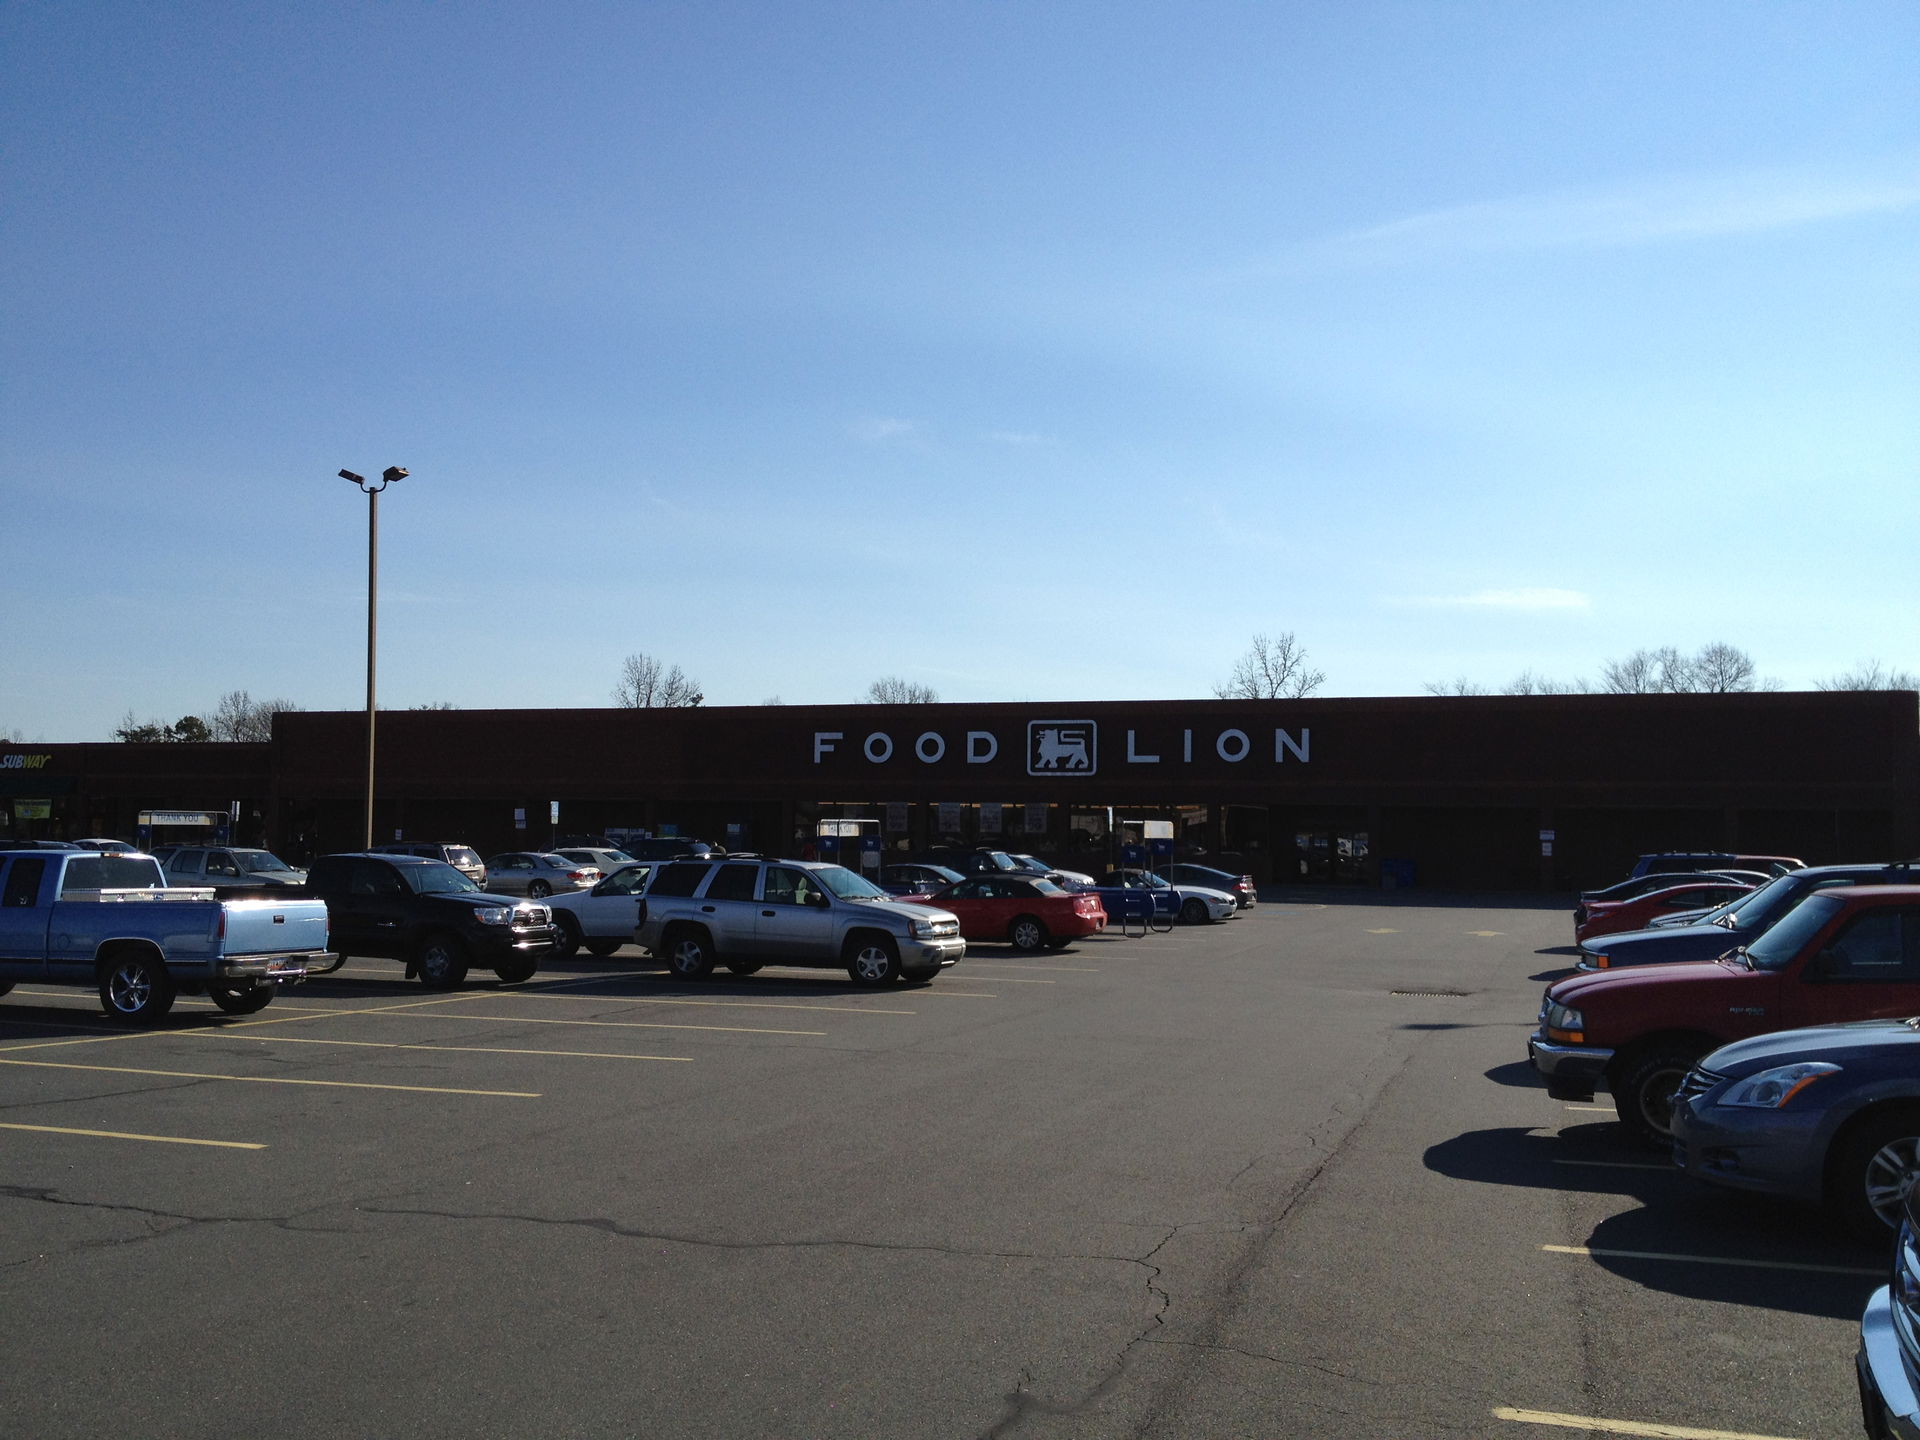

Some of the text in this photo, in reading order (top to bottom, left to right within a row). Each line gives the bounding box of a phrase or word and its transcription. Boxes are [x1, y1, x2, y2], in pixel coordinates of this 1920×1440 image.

[813, 727, 1311, 764] FOOD LION
[0, 754, 52, 769] SUBWAY
[156, 813, 199, 822] THANK YOU
